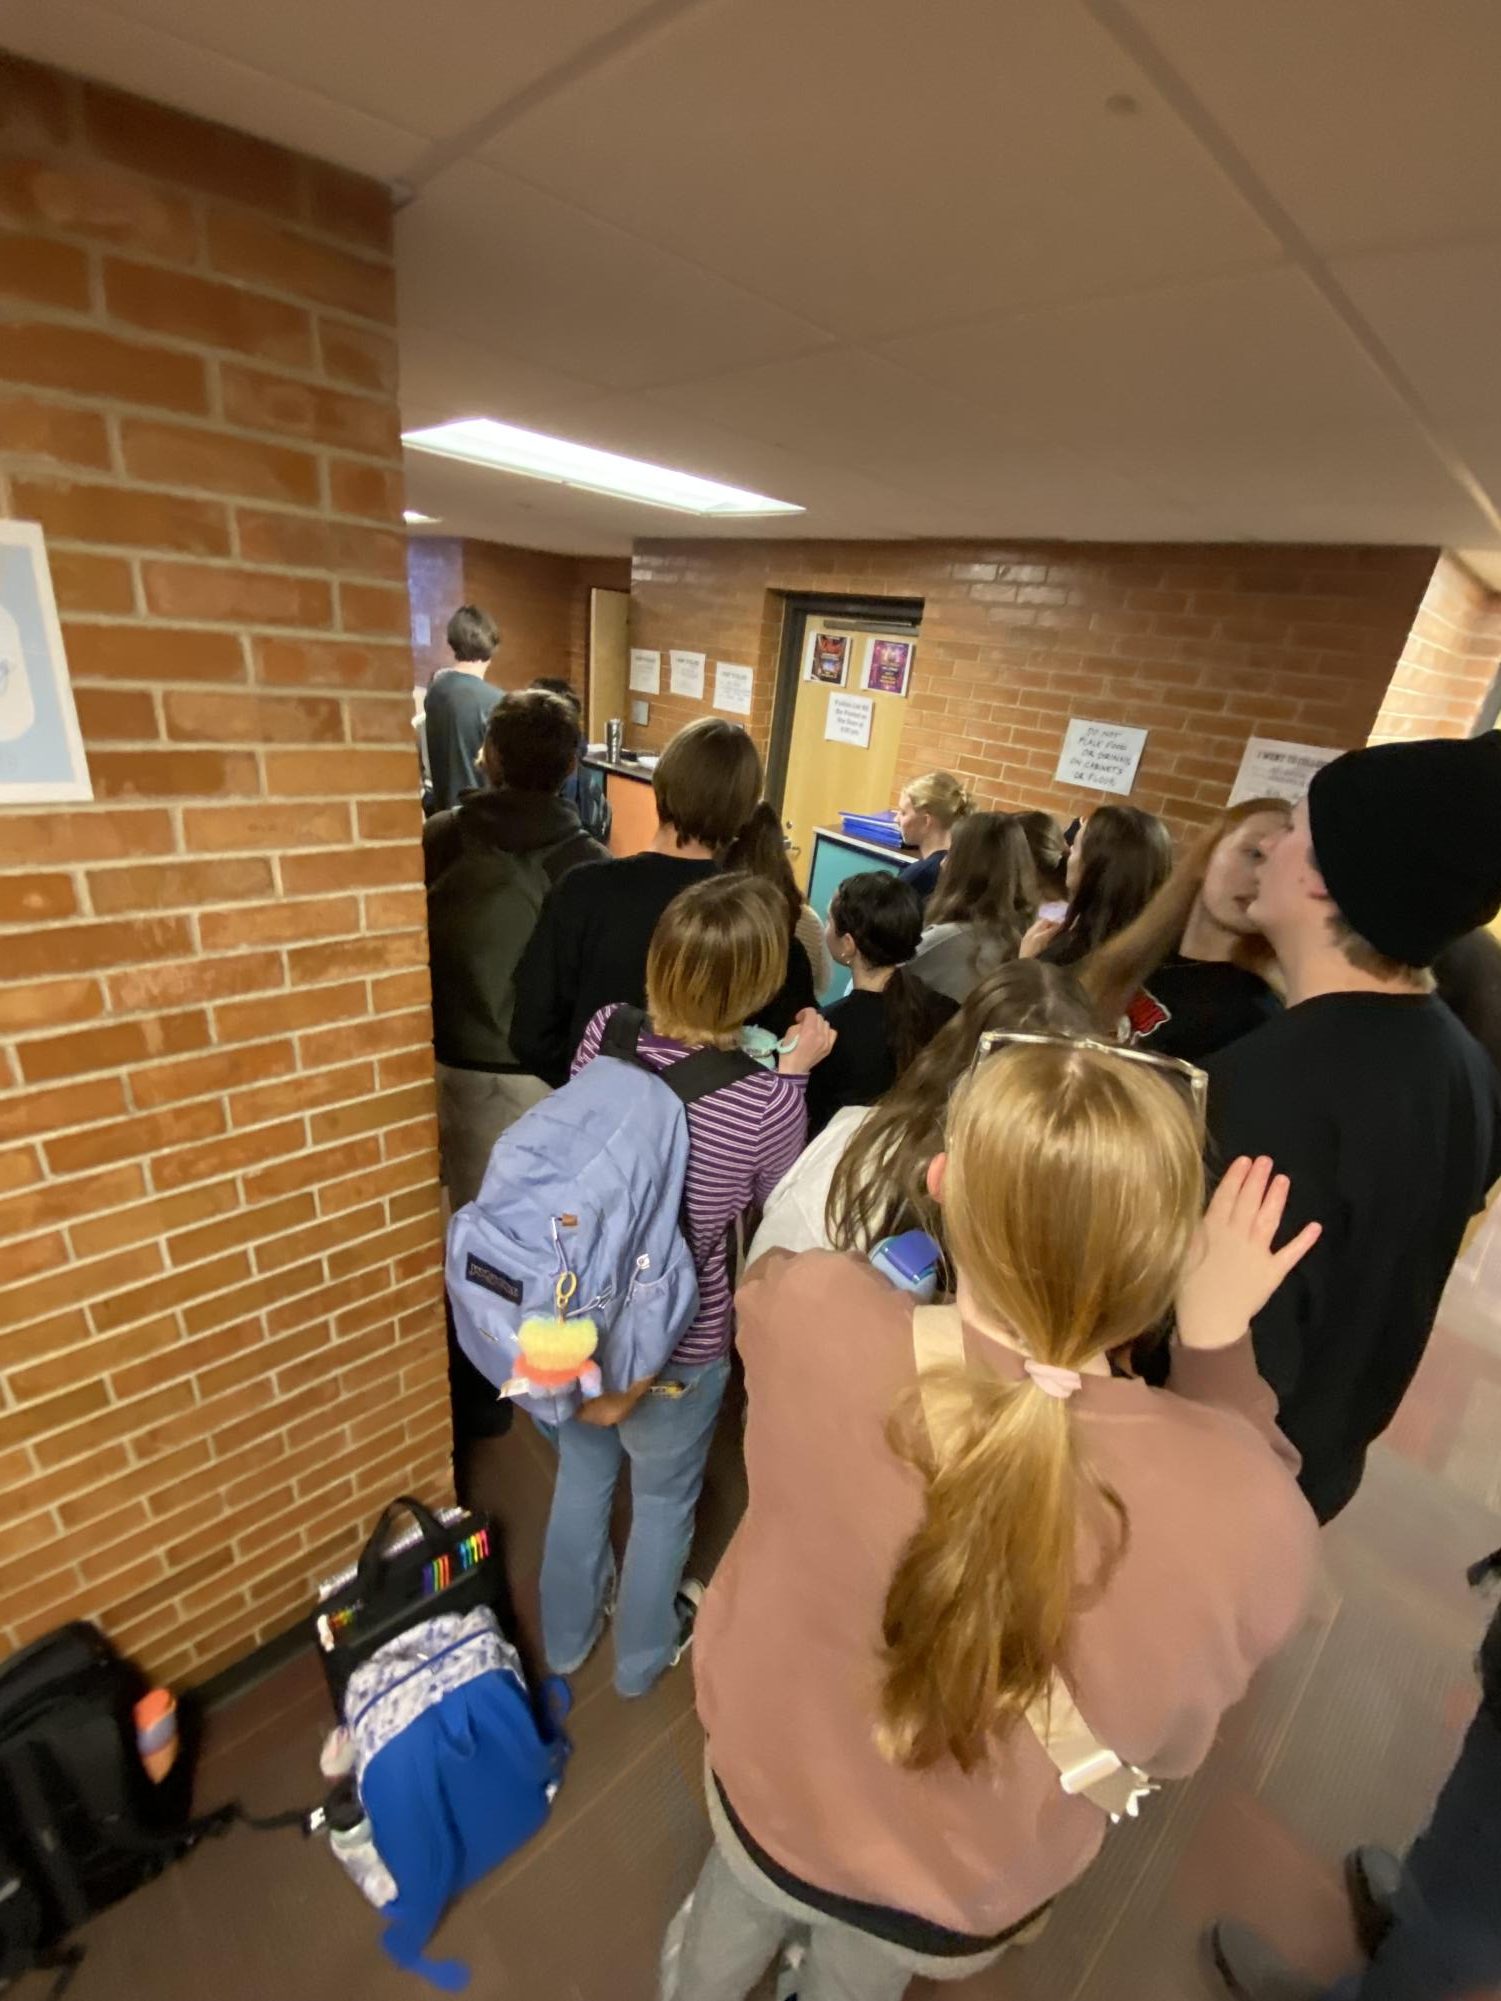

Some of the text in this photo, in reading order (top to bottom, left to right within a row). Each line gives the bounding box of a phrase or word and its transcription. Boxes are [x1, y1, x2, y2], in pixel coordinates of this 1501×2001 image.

[1087, 727, 1123, 738] DO NOT
[1105, 741, 1127, 750] FOOD
[1081, 748, 1094, 757] OR
[1083, 761, 1123, 775] CABINETS
